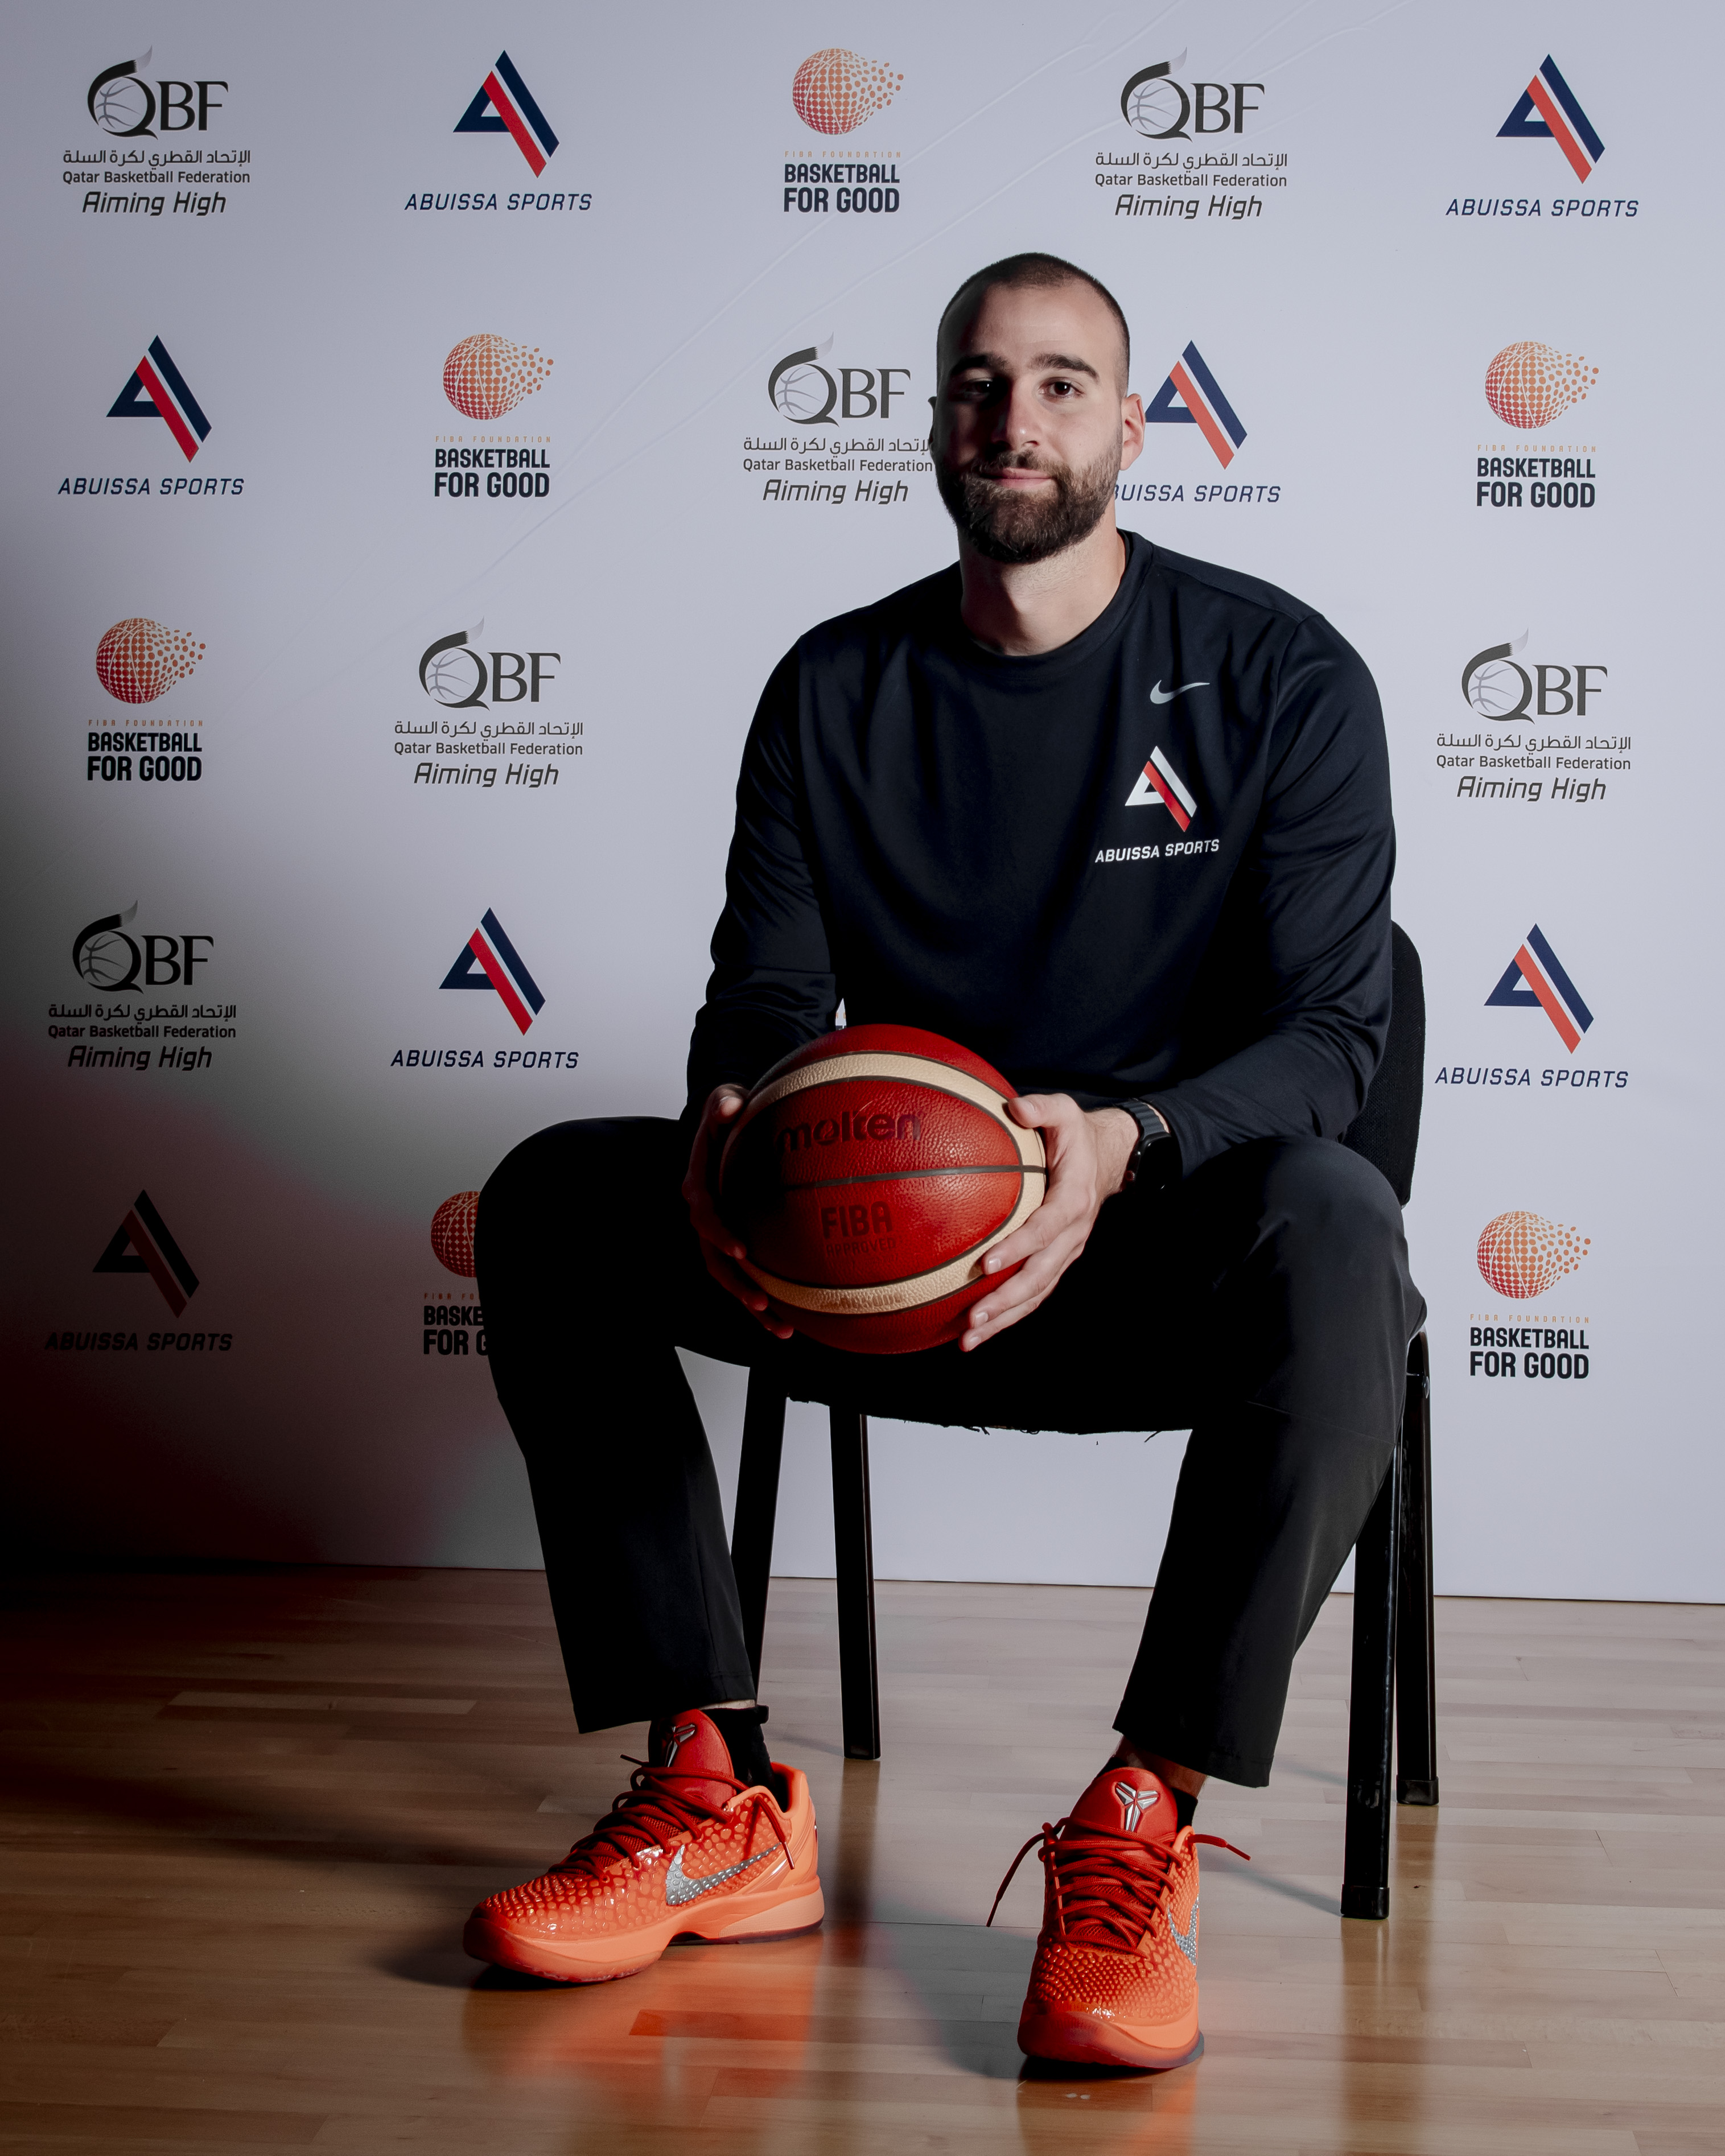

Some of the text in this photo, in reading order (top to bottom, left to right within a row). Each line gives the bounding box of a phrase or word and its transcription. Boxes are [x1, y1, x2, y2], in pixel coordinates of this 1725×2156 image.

[88, 59, 229, 140] QBF
[1121, 59, 1266, 142] QBF
[63, 150, 250, 170] الإتحاد القطري لكرة السلة
[1096, 152, 1287, 173] الإتحاد القطري لكرة السلة
[63, 171, 249, 184] Qatar Basketball Federation
[785, 164, 900, 183] BASKETBALL
[1096, 174, 1286, 187] Qatar Basketball Federation
[83, 191, 226, 216] Aiming High
[405, 193, 592, 210] ABUISSA SPORTS
[784, 187, 899, 213] FOR GOOD
[1115, 195, 1262, 220] Aiming High
[1446, 199, 1638, 217] ABUISSA SPORTS
[768, 345, 912, 428] QBF
[744, 438, 786, 450] السلة
[791, 438, 825, 454] لكرة
[830, 439, 884, 457] القطري
[435, 448, 550, 468] BASKETBALL
[744, 459, 932, 472] Qatar Basketball Federation
[1477, 457, 1595, 478] BASKETBALL
[58, 478, 244, 494] ABUISSA SPORTS
[435, 472, 549, 497] FOR GOOD
[763, 480, 908, 504] Aiming High
[1195, 485, 1281, 502] SPORTS
[1477, 481, 1595, 508] FOR GOOD
[419, 629, 561, 711] QBF
[1462, 639, 1609, 724] QBF
[395, 721, 583, 741] الإتحاد القطري لكرة السلة
[88, 732, 202, 752] BASKETBALL
[394, 743, 582, 755] Qatar Basketball Federation
[1437, 733, 1631, 755] الإتحاد القطري لكرة السلة
[88, 756, 201, 781] FOR GOOD
[1437, 755, 1630, 769] Qatar Basketball Federation
[414, 762, 558, 788] Aiming High
[1457, 776, 1606, 802] Aiming High
[1095, 839, 1220, 863] ABUISSA SPORTS
[73, 912, 215, 994] QBF
[48, 1004, 236, 1025] الإتحاد القطري لكرة السلة
[48, 1025, 236, 1039] Qatar Basketball Federation
[67, 1045, 212, 1071] Aiming High
[390, 1050, 579, 1068] ABUISSA SPORTS
[1435, 1067, 1628, 1087] ABUISSA SPORTS
[775, 1111, 922, 1155] molten
[821, 1201, 893, 1239] FIBA
[826, 1237, 896, 1257] APPROVED
[424, 1305, 484, 1325] BASKE
[45, 1332, 232, 1351] ABUISSA SPORTS
[423, 1329, 468, 1355] FOR
[1471, 1327, 1589, 1349] BASKETBALL
[1471, 1351, 1588, 1379] FOR GOOD
